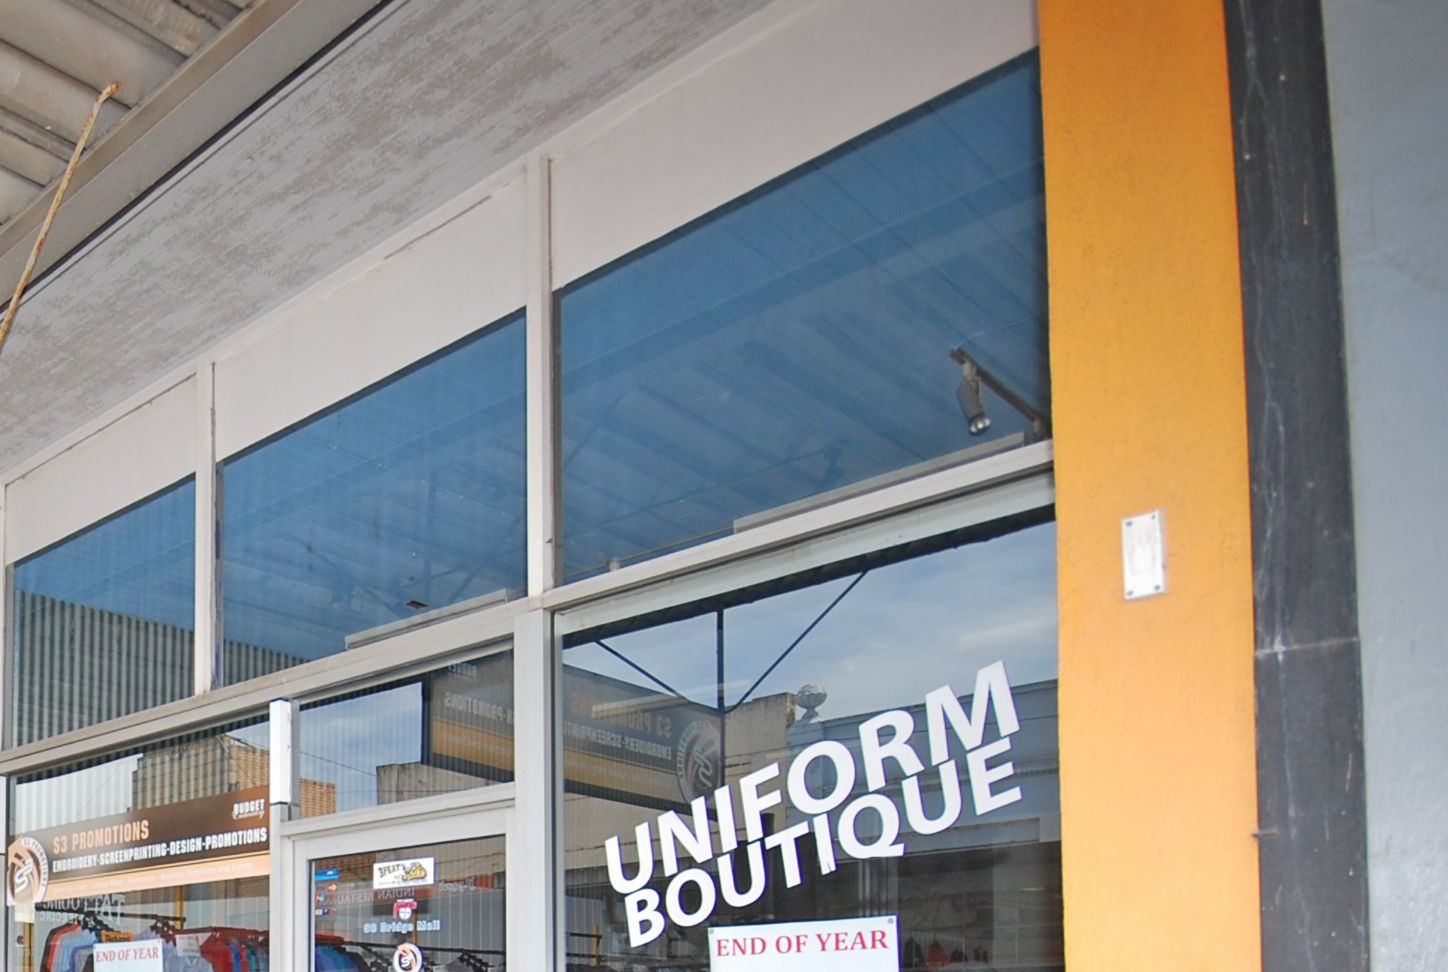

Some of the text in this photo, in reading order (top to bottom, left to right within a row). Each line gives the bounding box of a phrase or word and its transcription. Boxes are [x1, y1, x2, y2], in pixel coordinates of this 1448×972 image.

[604, 659, 1022, 896] UNIFORM
[232, 798, 266, 815] BUDGET
[53, 818, 150, 855] S3 PROMOTIONS
[624, 736, 1023, 949] BOUTIQUE
[380, 920, 414, 935] Bridge
[416, 919, 441, 932] Mall
[96, 946, 160, 963] END OF YEAR
[715, 929, 889, 958] END OF YEAR
